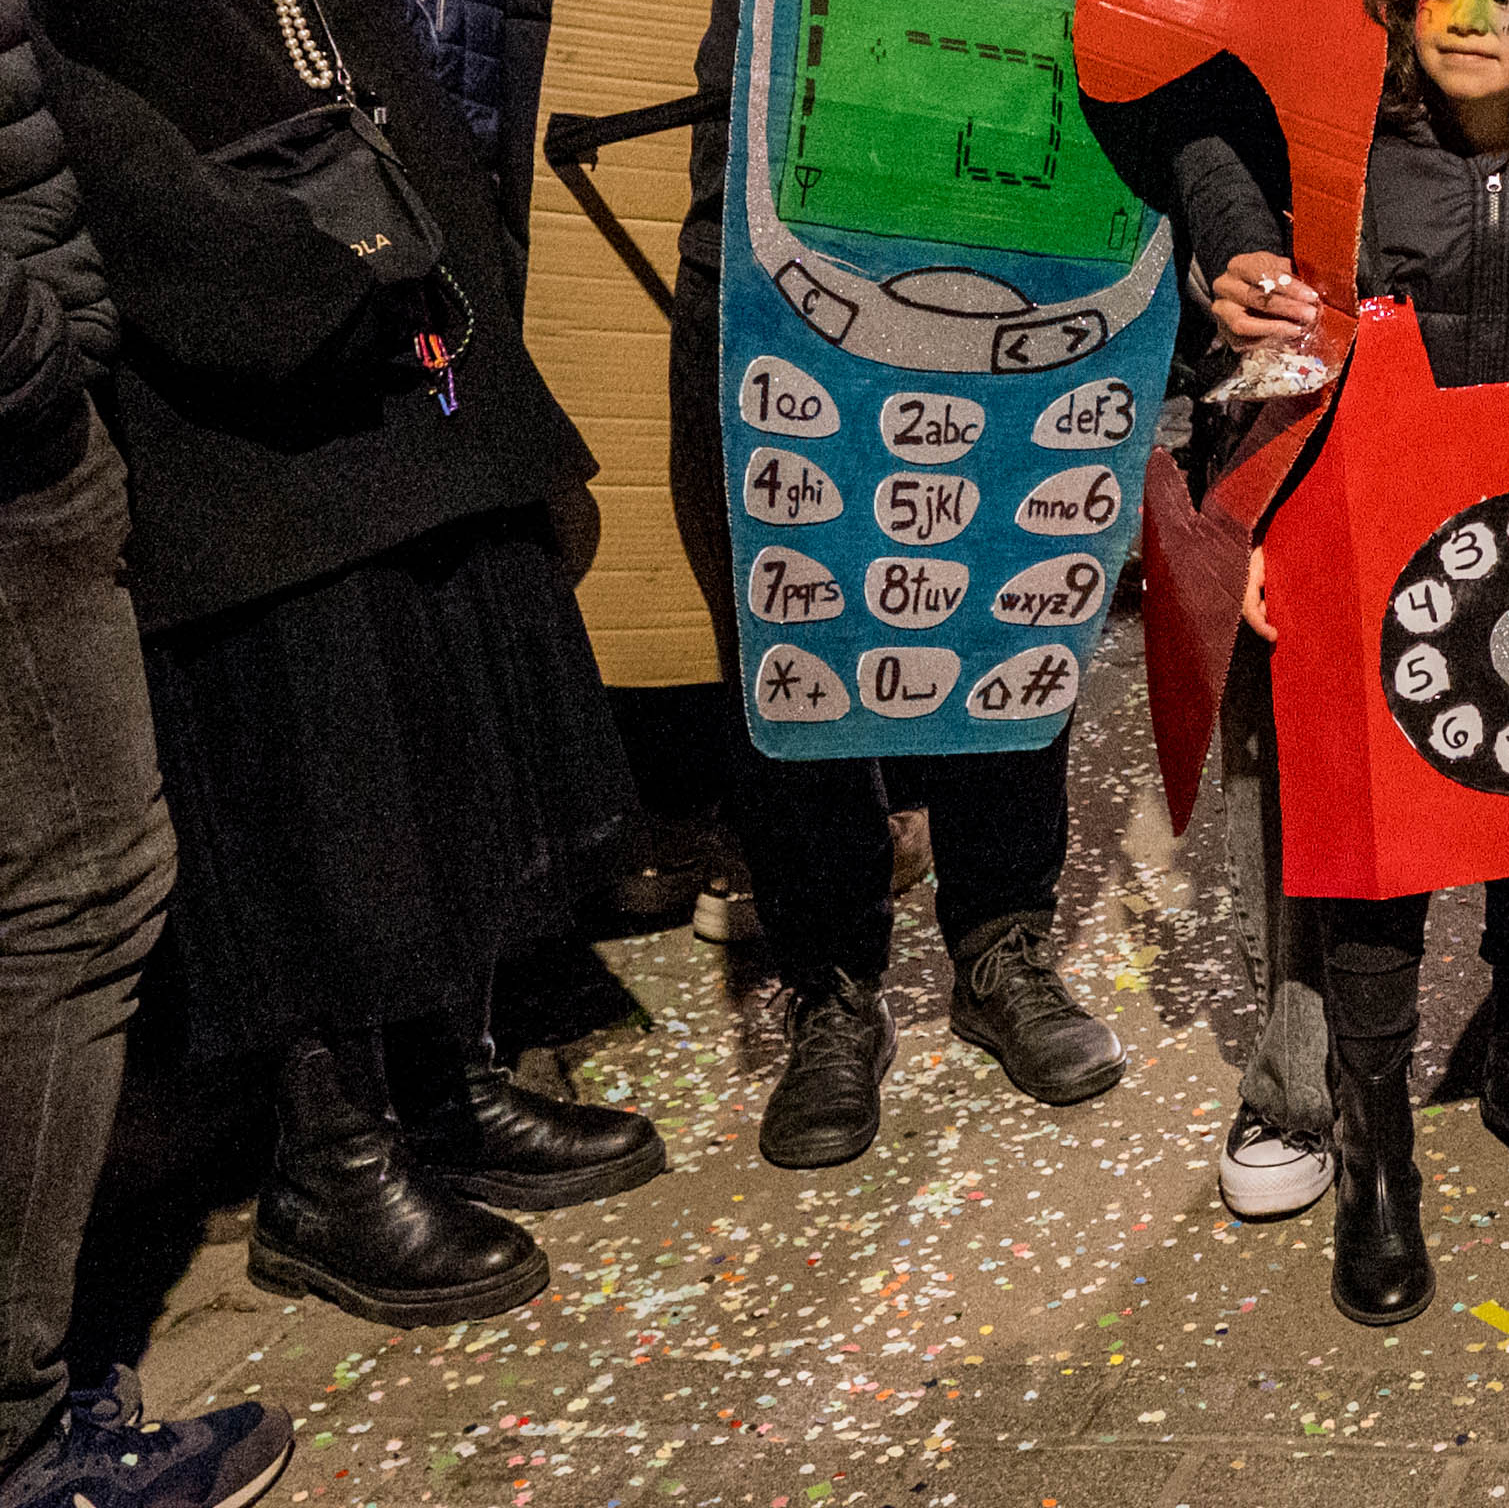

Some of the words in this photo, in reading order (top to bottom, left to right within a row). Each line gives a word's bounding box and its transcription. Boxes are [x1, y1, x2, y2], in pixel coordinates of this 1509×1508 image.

[1451, 531, 1483, 570] 3
[1408, 585, 1439, 623] 4
[1407, 657, 1433, 694] 5
[1442, 716, 1469, 749] 6
